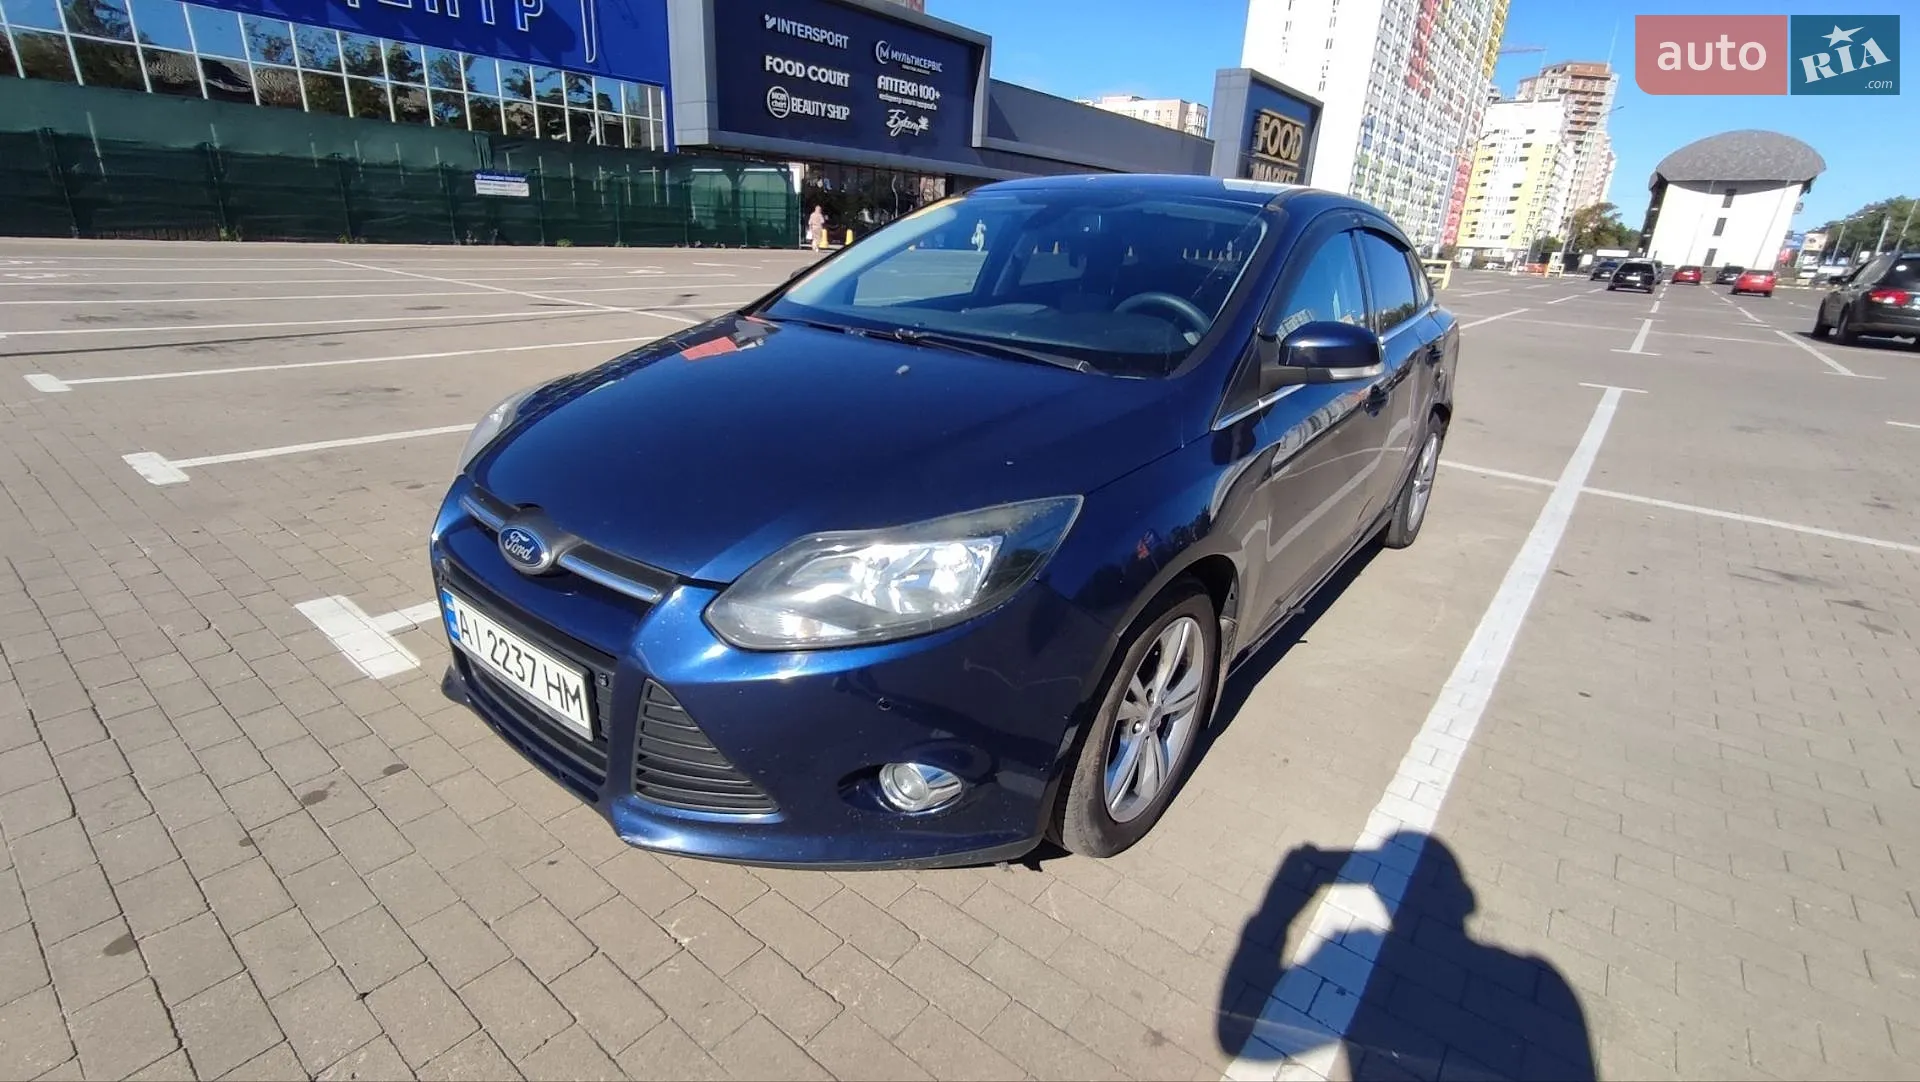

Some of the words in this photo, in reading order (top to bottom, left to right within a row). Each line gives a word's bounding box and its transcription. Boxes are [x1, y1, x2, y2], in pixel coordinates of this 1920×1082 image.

[777, 18, 849, 49] INTERSPORT
[765, 55, 806, 78] FOOD
[807, 66, 850, 88] COURT
[877, 75, 919, 97] АПТЕКА
[919, 84, 941, 101] 100+
[791, 97, 827, 117] BEAUTY
[827, 104, 850, 120] SHOP
[1257, 114, 1303, 161] FOOD
[504, 531, 532, 561] Ford
[487, 629, 536, 688] 2237
[543, 664, 584, 721] HM
